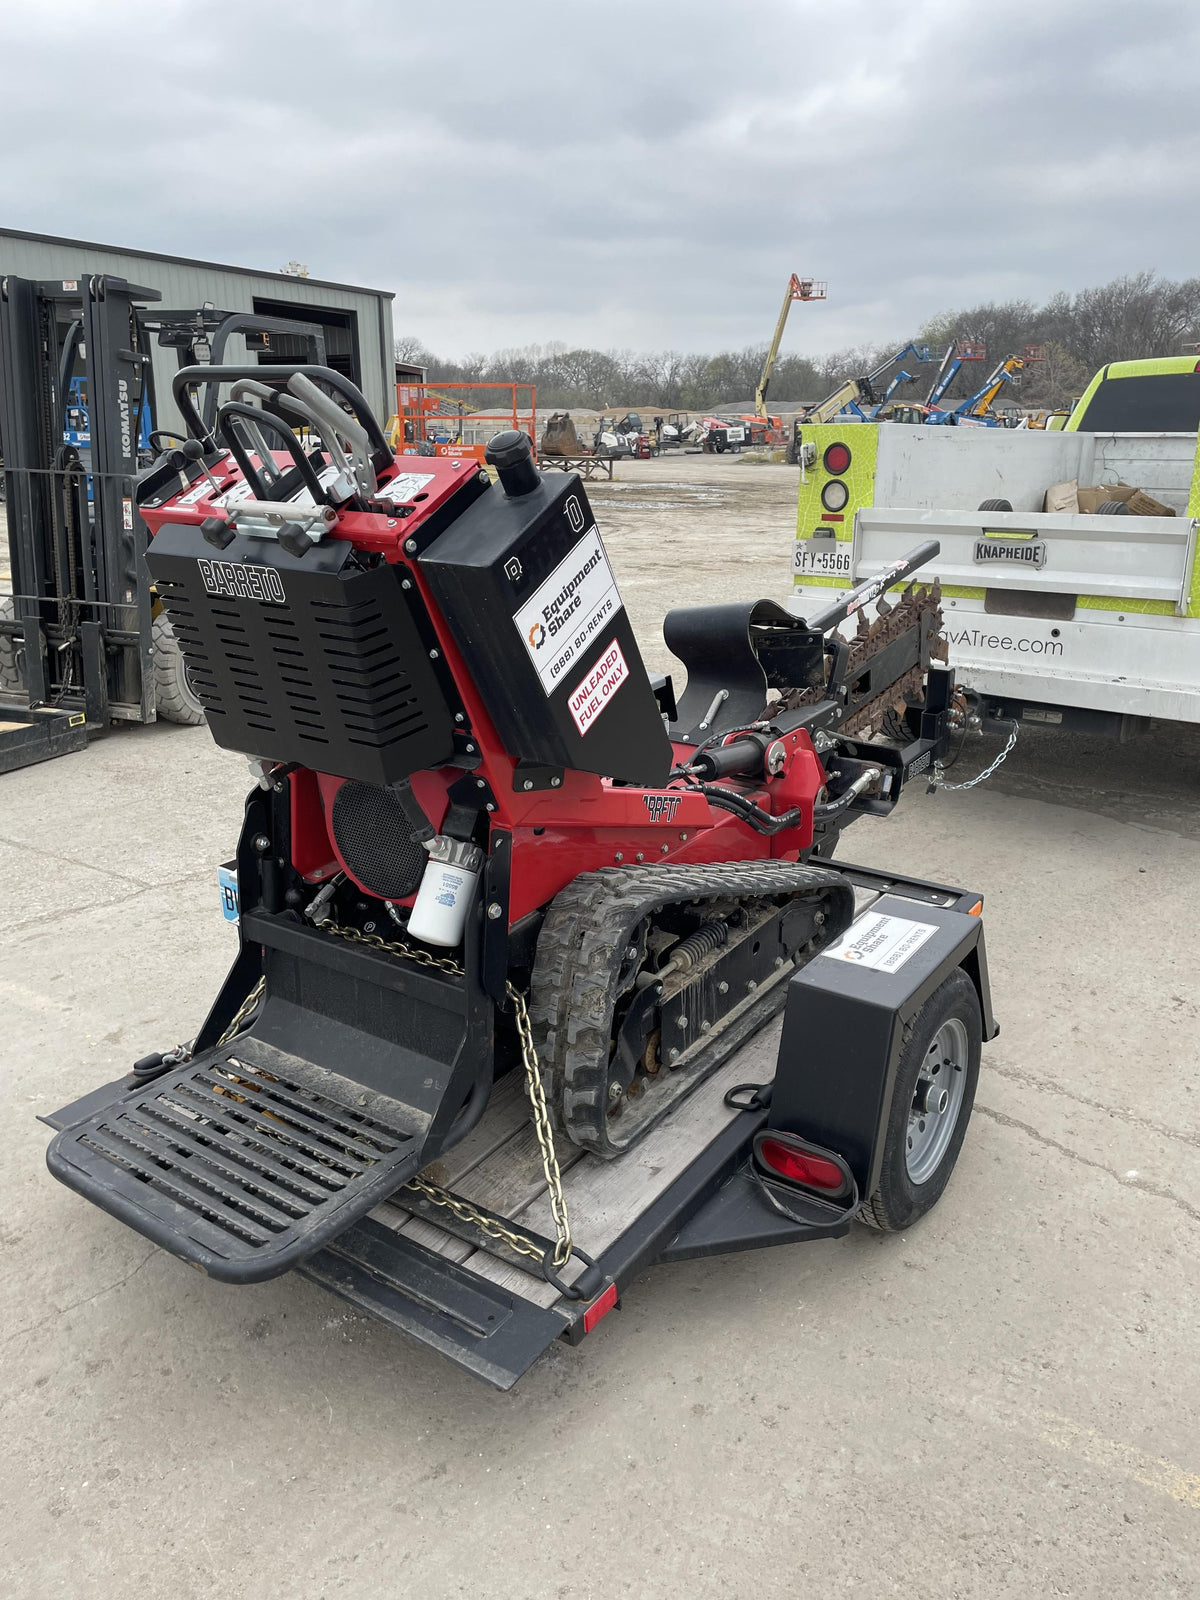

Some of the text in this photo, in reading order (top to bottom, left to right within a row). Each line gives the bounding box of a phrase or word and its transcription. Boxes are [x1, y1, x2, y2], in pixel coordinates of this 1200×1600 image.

[118, 379, 131, 458] KOMATSU
[795, 551, 850, 571] SFY 5566
[976, 543, 1041, 562] KNAPHEIDE
[197, 558, 286, 603] BARRETO
[541, 548, 602, 623] Equipment
[547, 594, 582, 637] Share
[550, 599, 613, 679] (888) 80-RENTS
[937, 629, 1064, 656] avATree.com
[571, 649, 618, 712] UNLEADED
[579, 663, 624, 727] FUEL ONLY
[224, 886, 240, 914] B
[848, 916, 892, 950] Equipment
[862, 933, 889, 954] Share
